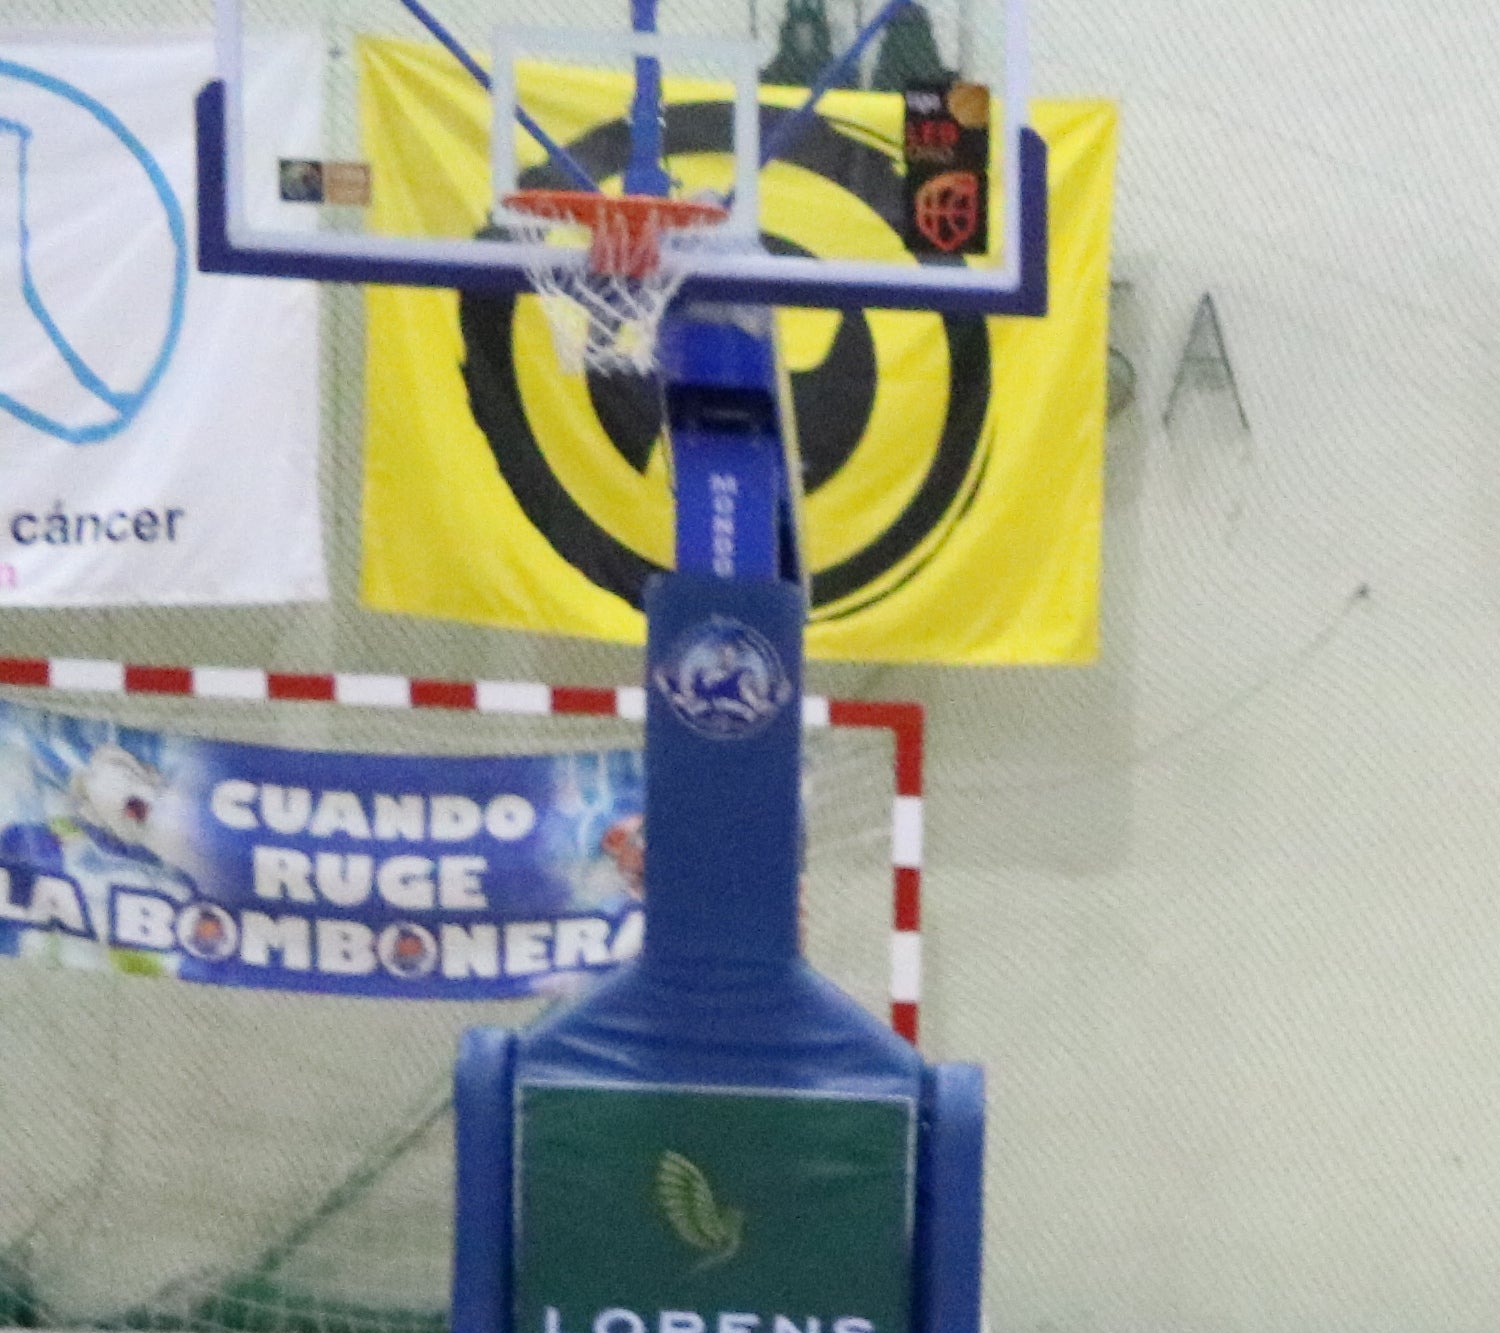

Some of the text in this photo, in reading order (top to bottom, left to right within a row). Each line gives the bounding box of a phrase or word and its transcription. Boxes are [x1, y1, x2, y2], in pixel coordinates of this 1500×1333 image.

[9, 498, 186, 546] cáncer
[210, 779, 535, 843] CUANDO
[0, 867, 89, 932] LA
[251, 845, 489, 910] RUGE
